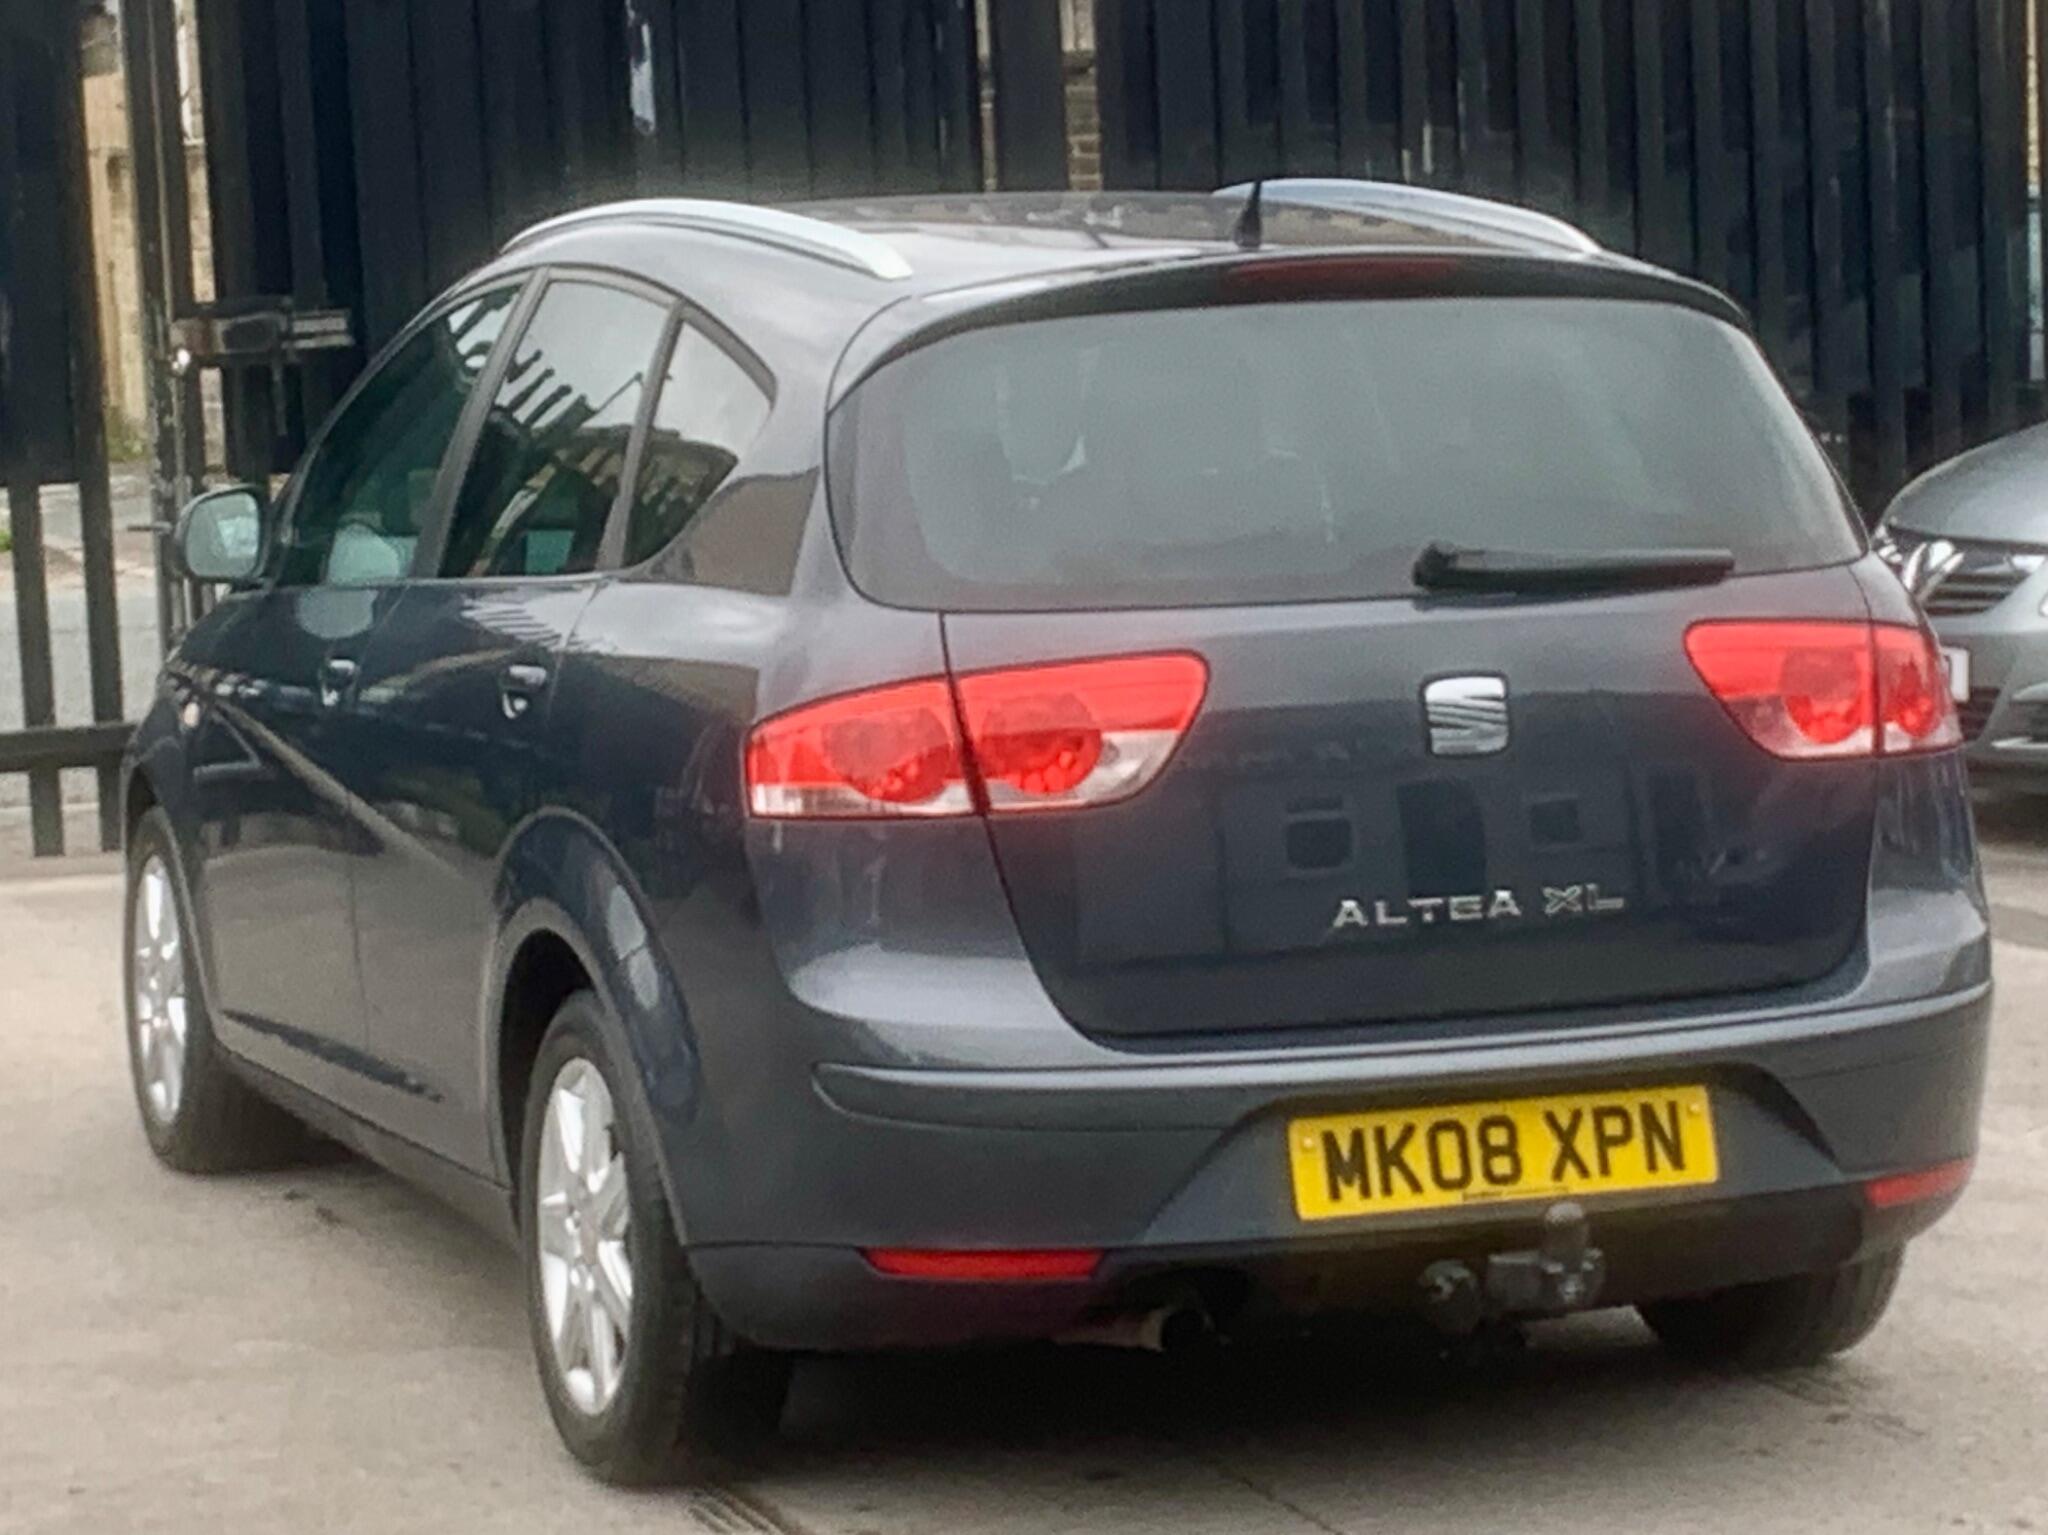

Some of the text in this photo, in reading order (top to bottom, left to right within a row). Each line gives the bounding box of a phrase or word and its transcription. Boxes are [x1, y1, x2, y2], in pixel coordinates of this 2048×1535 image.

[1333, 882, 1624, 928] ALTEA XL
[1321, 1100, 1686, 1202] MK08 XPN
